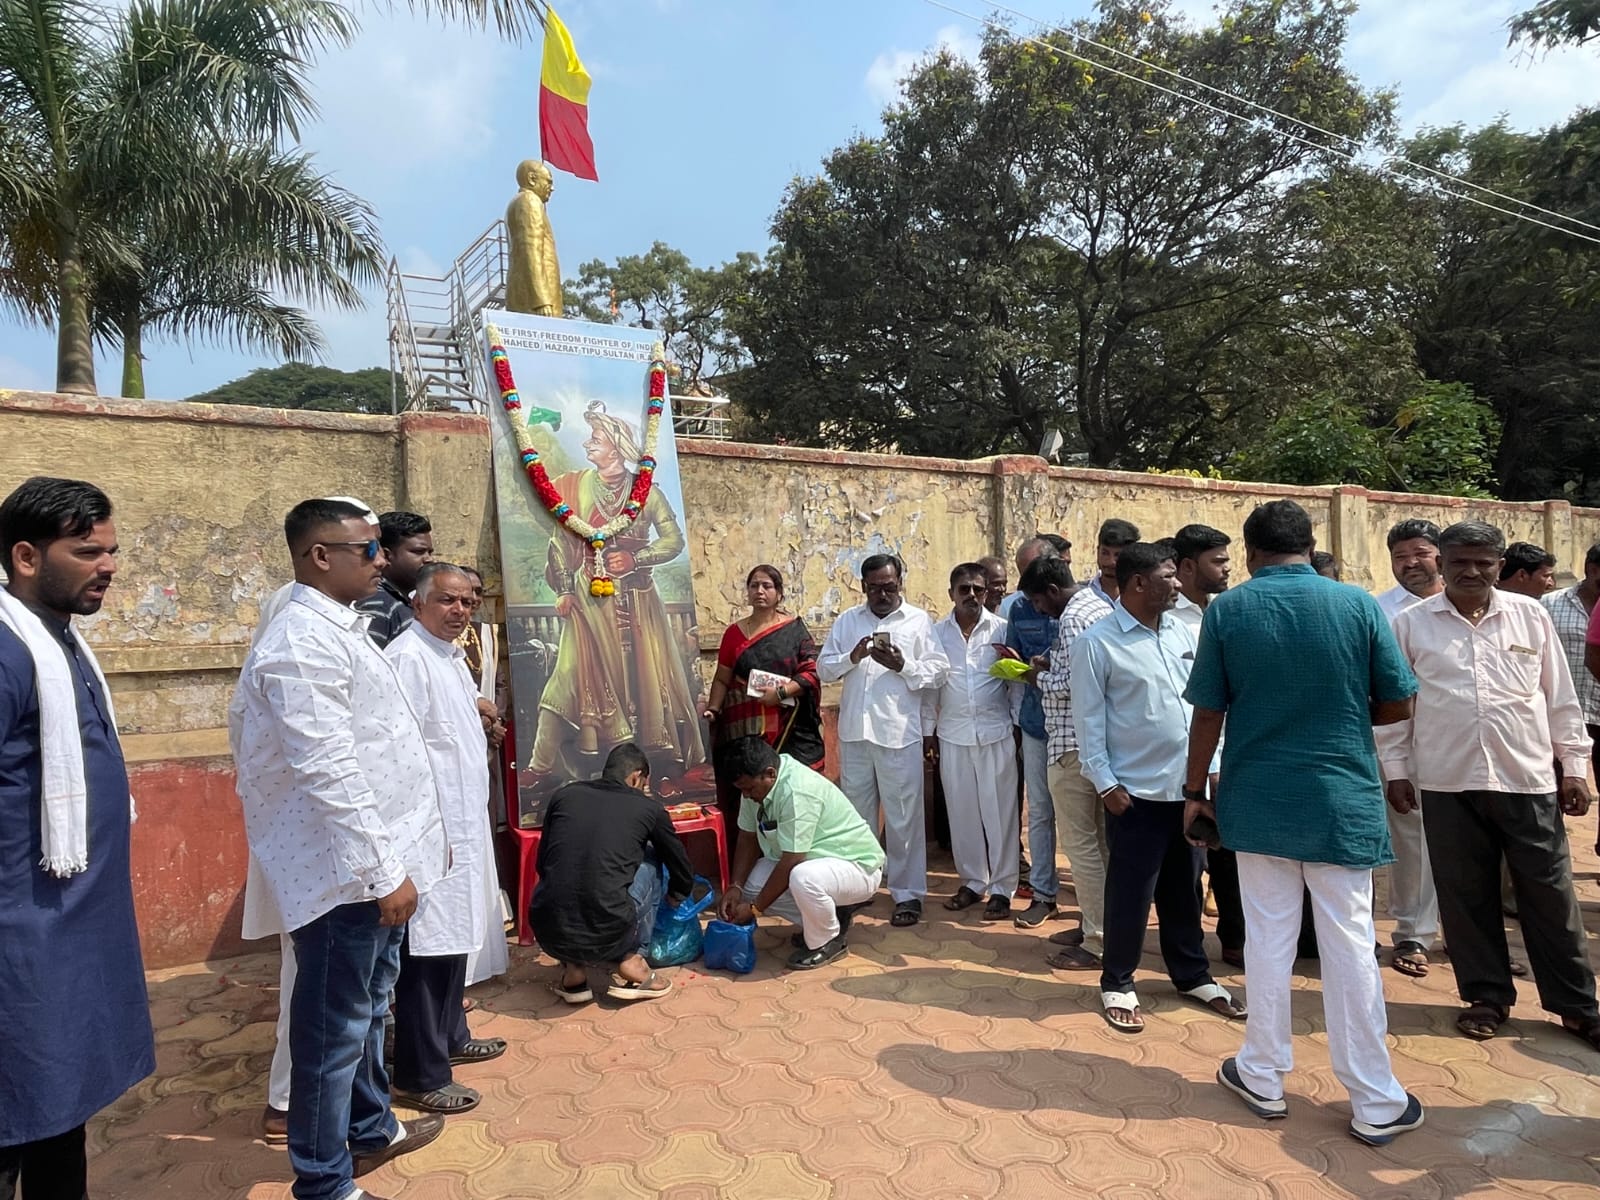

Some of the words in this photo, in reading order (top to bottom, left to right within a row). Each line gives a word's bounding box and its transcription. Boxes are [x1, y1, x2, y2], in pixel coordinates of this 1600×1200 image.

[512, 328, 538, 338] FIRST
[540, 332, 582, 343] FREEDOM
[583, 337, 619, 347] FIGHTER
[503, 339, 540, 349] HAHEED
[544, 343, 579, 353] HAZRAT
[581, 347, 601, 355] TIPU
[603, 350, 635, 359] SULTAN
